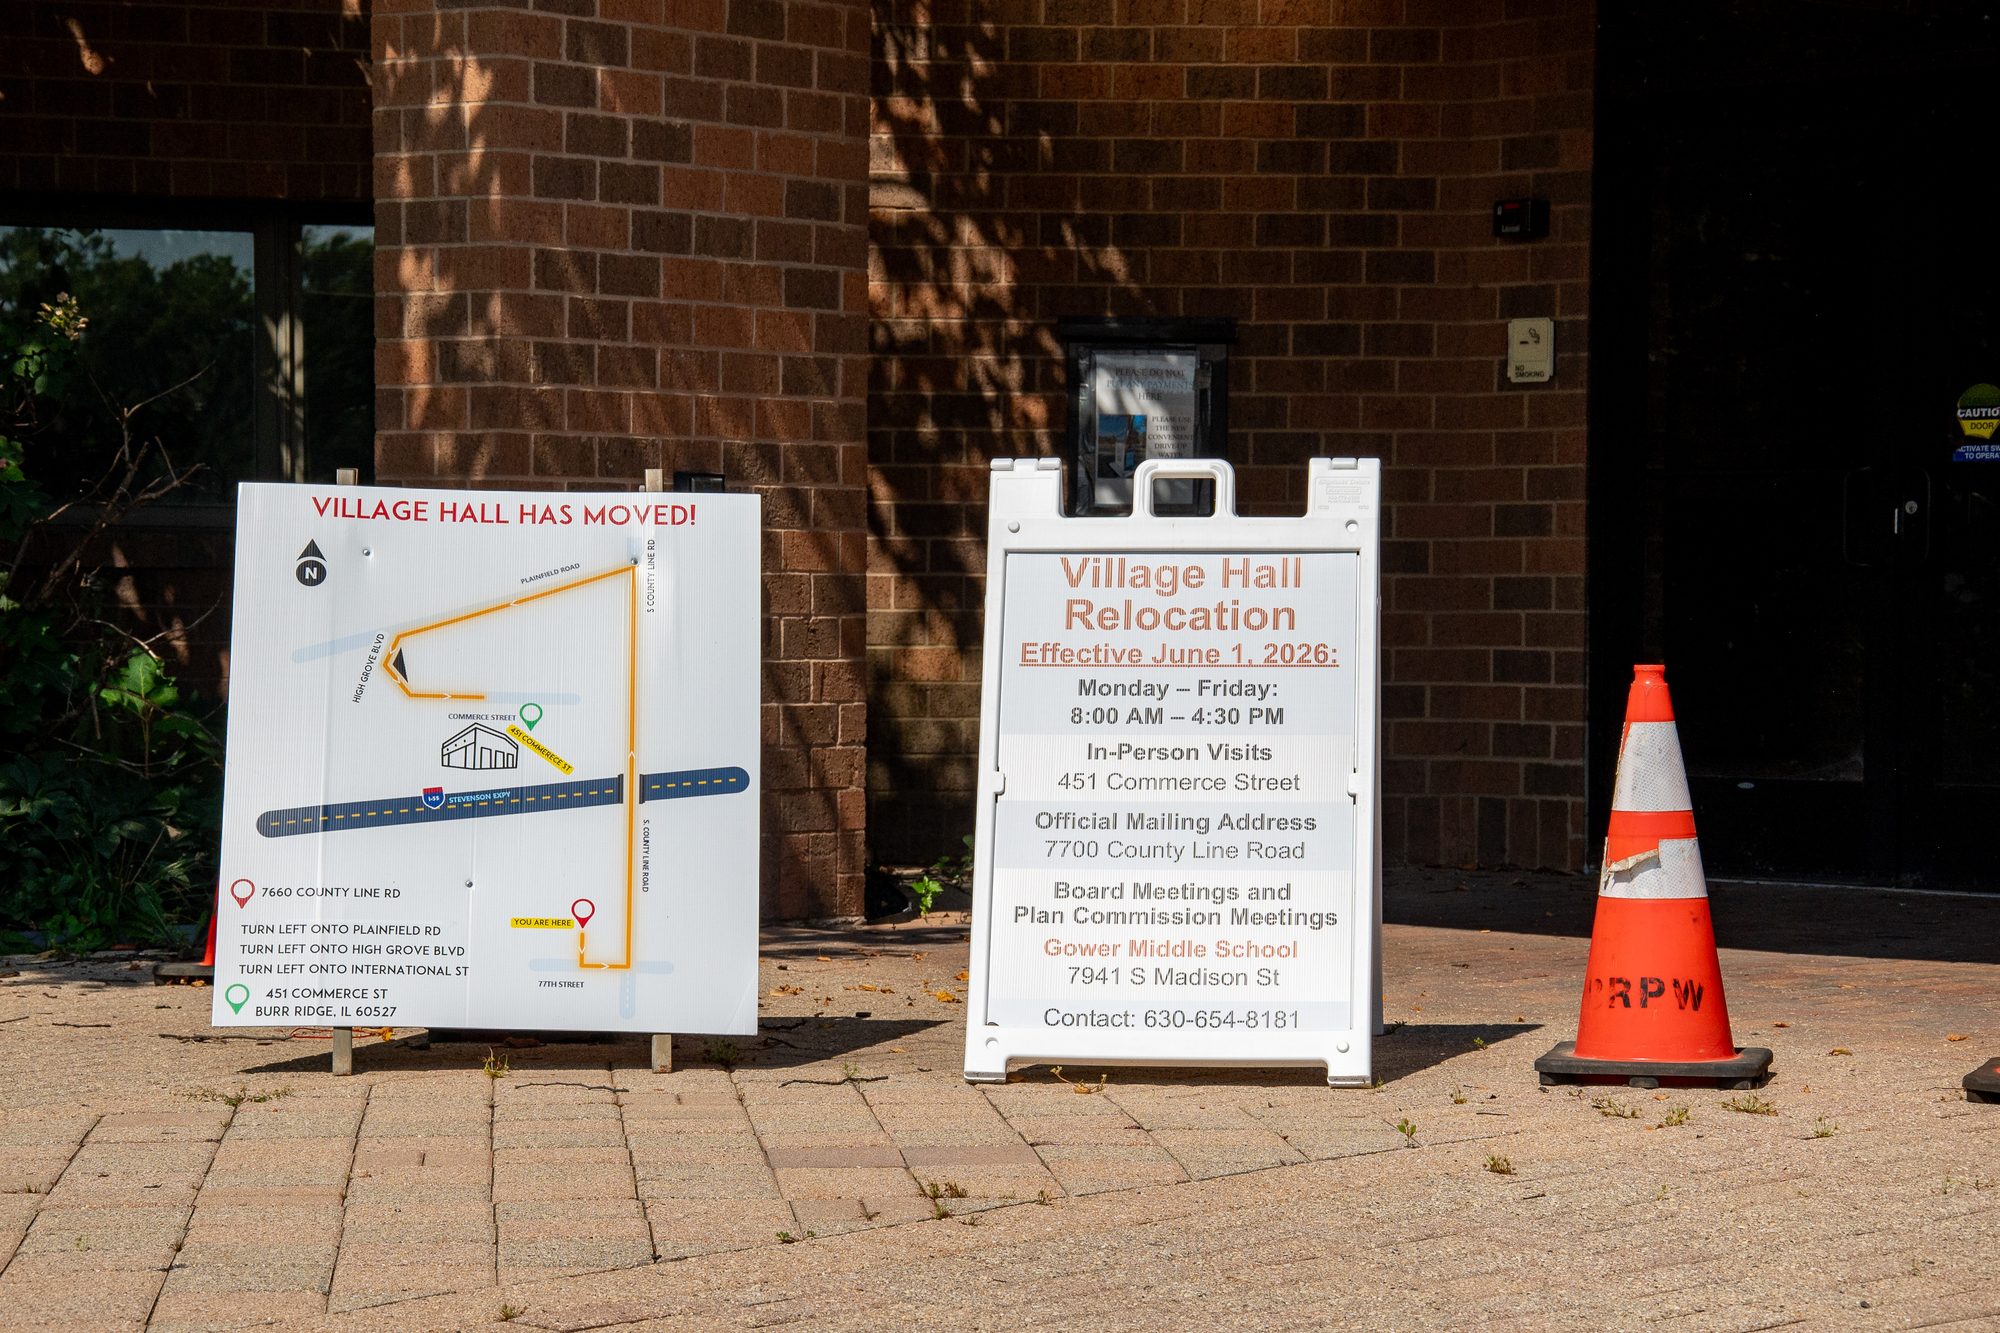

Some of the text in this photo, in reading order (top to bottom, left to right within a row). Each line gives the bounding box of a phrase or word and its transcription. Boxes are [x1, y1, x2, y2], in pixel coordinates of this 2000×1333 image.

[1115, 368, 1147, 377] PLEASE
[1139, 392, 1162, 400] HERE
[1957, 408, 2000, 417] CAUTIO
[312, 497, 695, 525] VILLAGE HALL HAS MOVED!
[647, 539, 655, 550] RD
[647, 553, 655, 570] LINE
[305, 566, 318, 579] N
[521, 563, 580, 584] PLAINFIELD ROAD
[1060, 557, 1300, 597] Village Hall
[647, 573, 655, 606] COUNTY
[1066, 599, 1295, 631] Relocation
[1020, 643, 1338, 666] Effective June 1, 2026:
[352, 634, 384, 703] HIGH GROVE BLVD
[1079, 679, 1169, 701] Monday
[1198, 680, 1277, 701] Friday:
[448, 713, 489, 721] COMMERCE
[1071, 708, 1118, 724] 8:00
[1126, 708, 1163, 724] AM
[1192, 708, 1239, 724] 4:30
[1250, 708, 1283, 724] PM
[510, 727, 572, 772] 451 COMMERECE ST
[1088, 743, 1272, 760] In-Person Visits
[1058, 773, 1300, 790] 451 Commerce Street
[449, 791, 511, 804] STEVENSON EXPY
[1036, 812, 1316, 834] Official Mailing Address
[1045, 841, 1304, 863] 7700 County Line Road
[262, 888, 400, 898] 7660 COUNTY LINE RD
[1055, 882, 1291, 904] Board Meetings and
[513, 918, 571, 926] YOU ARE HERE
[1015, 906, 1337, 930] Plan Commission Meetings
[241, 924, 440, 935] TURN LEFT ONTO PLAINFIELD RD
[240, 944, 464, 956] TURN LEFT ONTO HIGH GROVE BLVD
[1044, 939, 1297, 958] Gower Middle School
[239, 964, 469, 976] TURN LEFT ONTO INTERNATIONAL ST
[1069, 967, 1279, 986] 7941 S Madison St
[266, 988, 388, 999] 451 COMMERCE ST
[256, 1006, 396, 1017] BURR RIDGE, IL 60527
[1044, 1008, 1297, 1028] Contact: 630-654-8181
